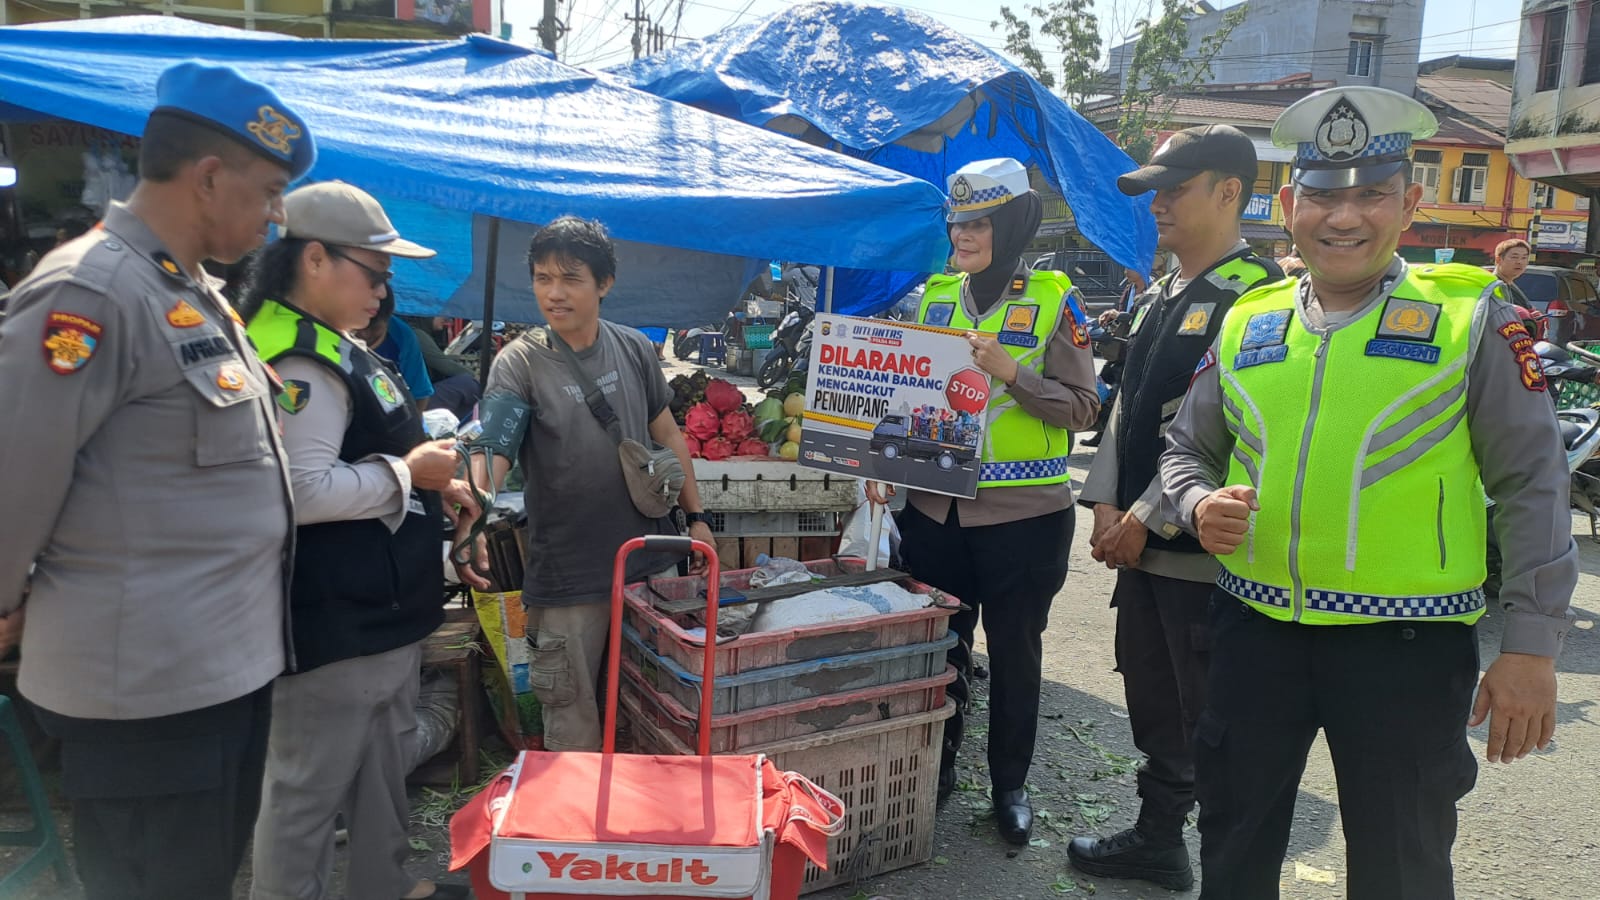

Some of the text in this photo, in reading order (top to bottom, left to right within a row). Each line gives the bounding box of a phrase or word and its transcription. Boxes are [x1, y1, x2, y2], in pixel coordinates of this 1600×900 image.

[852, 324, 904, 340] DITLANTAS
[819, 343, 932, 378] DILARANG
[816, 378, 896, 398] MENGANGKUT
[818, 364, 943, 392] KENDARAAN BARANG
[950, 380, 986, 403] STOP
[813, 389, 890, 419] PENUMPANG
[536, 850, 719, 886] Yakult
